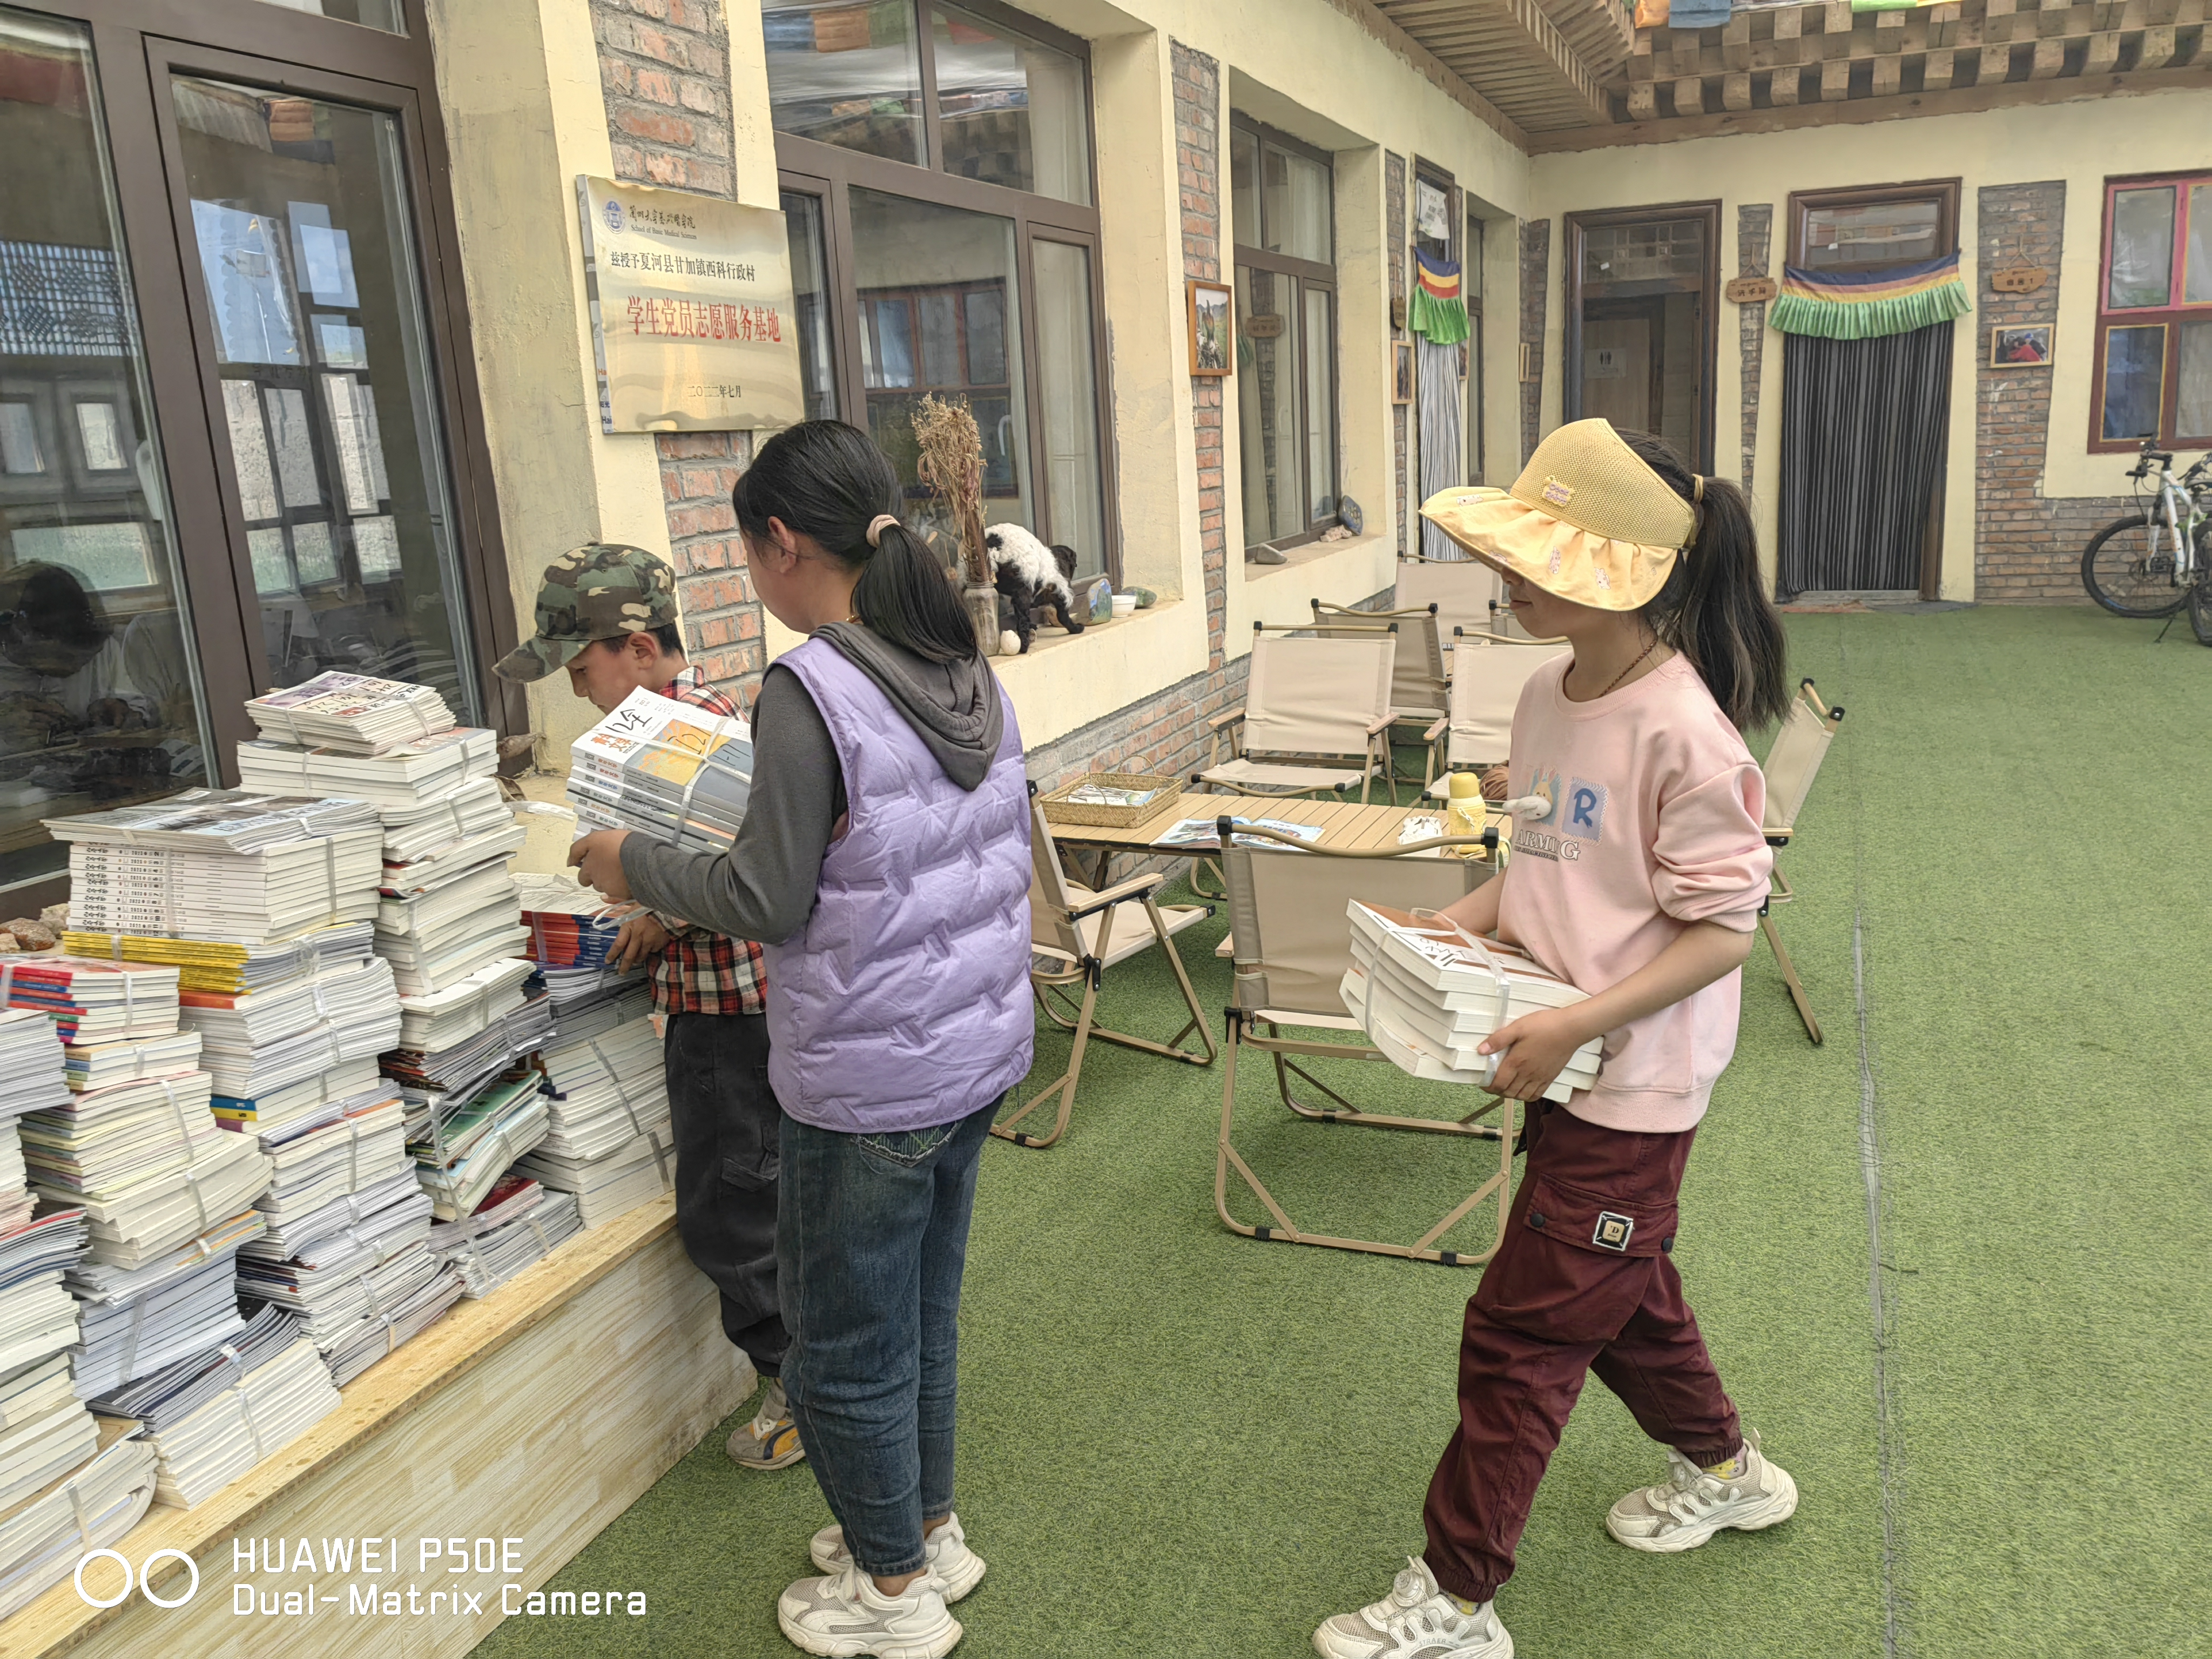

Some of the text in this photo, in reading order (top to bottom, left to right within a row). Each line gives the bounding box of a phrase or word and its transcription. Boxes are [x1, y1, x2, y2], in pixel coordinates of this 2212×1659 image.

[631, 224, 645, 233] School
[664, 229, 680, 238] Medical
[610, 251, 755, 282] 兹授予夏河县甘加镇西科行政村
[627, 294, 781, 343] 学生党员志愿服务基地
[1573, 787, 1597, 828] R
